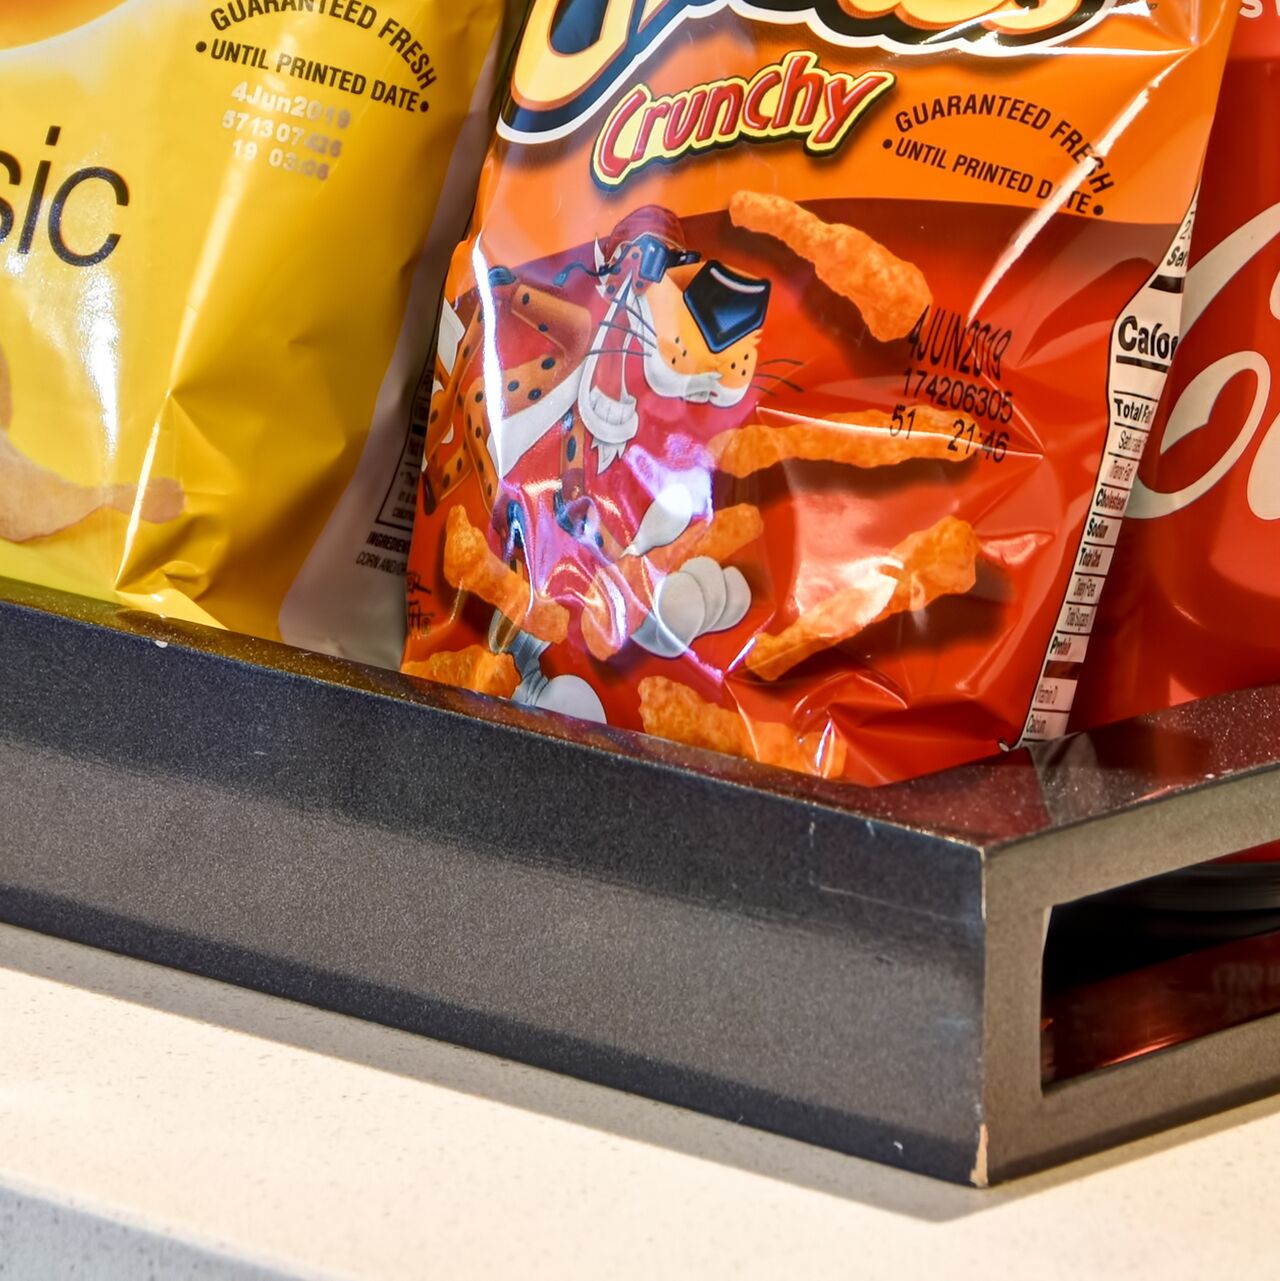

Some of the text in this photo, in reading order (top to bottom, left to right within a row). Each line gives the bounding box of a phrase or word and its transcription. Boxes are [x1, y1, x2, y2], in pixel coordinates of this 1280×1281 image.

[210, 38, 420, 112] UNTIL PRINTED DATE
[377, 17, 438, 91] FRESH
[231, 80, 352, 130] 4Jun2019
[595, 52, 895, 186] Crunchy
[232, 138, 258, 161] 19
[895, 93, 1115, 194] GUARANTEED FRESH
[895, 137, 1092, 214] UNTIL PRINTED DTE
[908, 304, 1012, 381] 4JUN2019
[903, 366, 1013, 424] 174206305
[1114, 398, 1143, 422] Total
[889, 404, 1010, 463] 51 21:46
